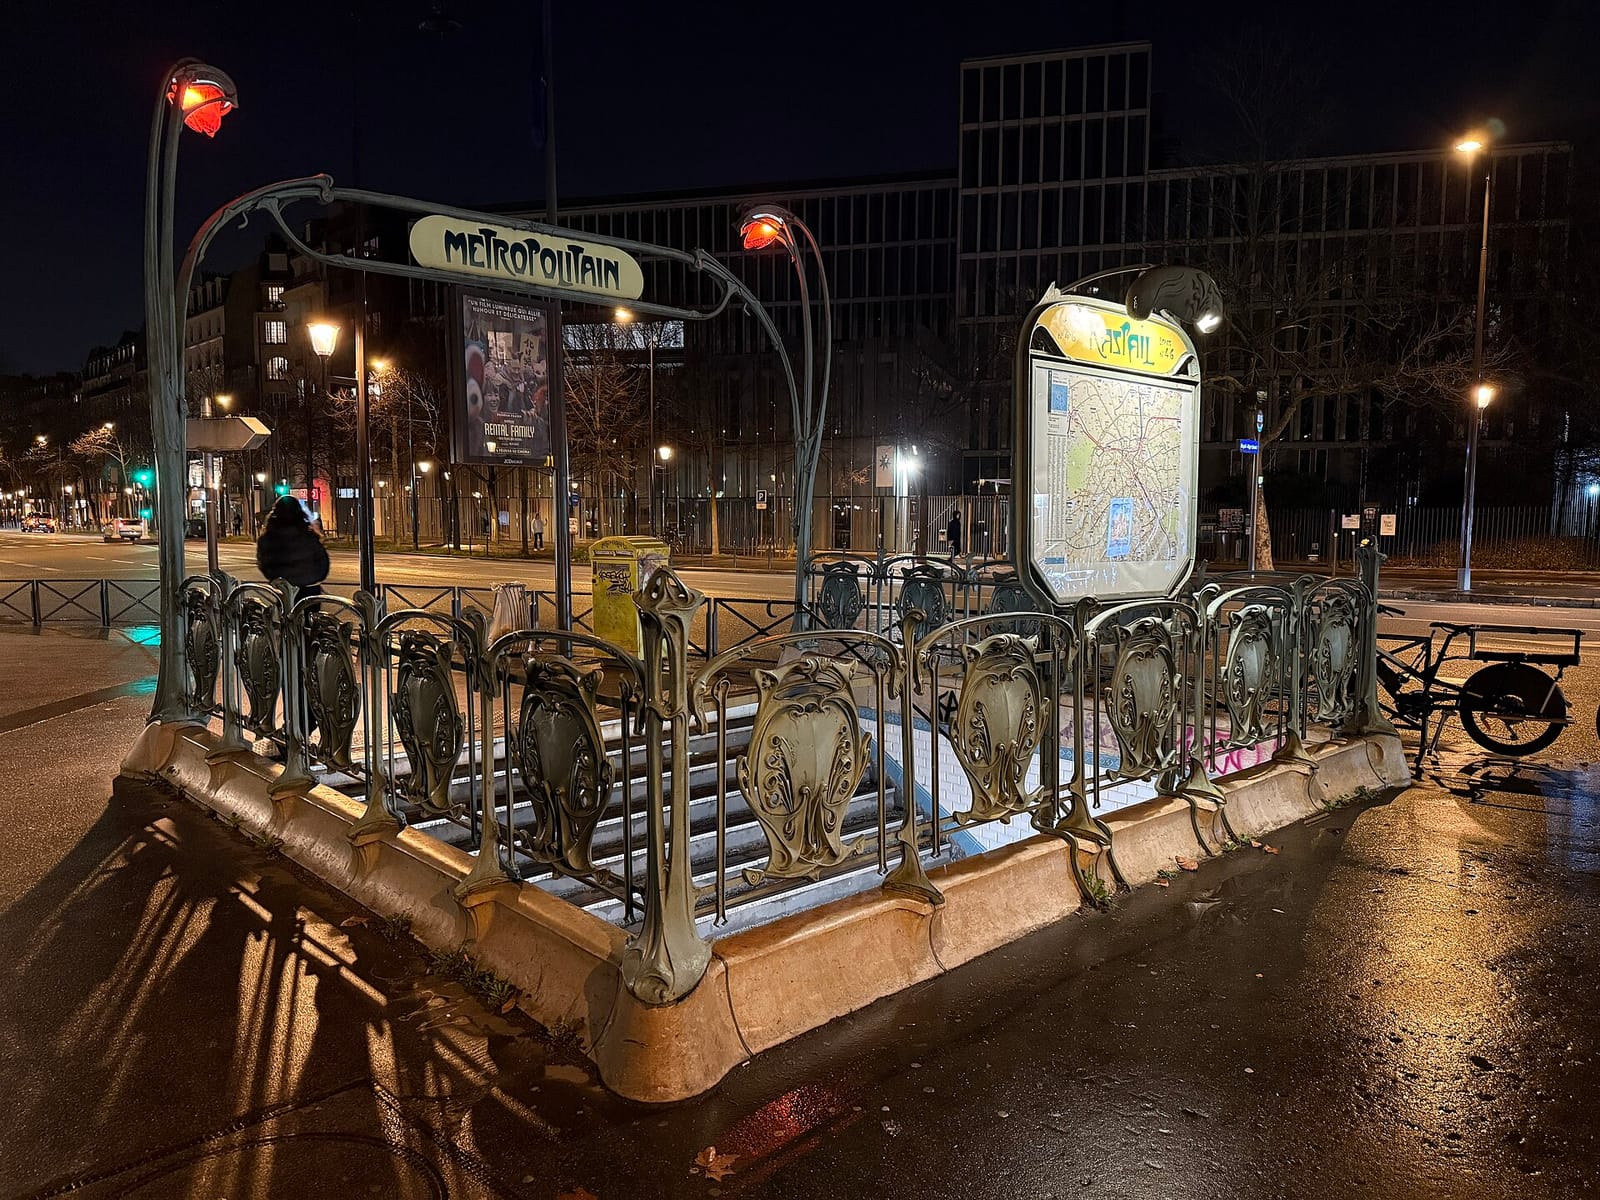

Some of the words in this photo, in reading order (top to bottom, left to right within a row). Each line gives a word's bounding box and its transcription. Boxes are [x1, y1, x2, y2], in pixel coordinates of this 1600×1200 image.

[444, 228, 620, 290] METROPOLITAIN
[479, 301, 491, 309] FILM
[484, 423, 509, 437] RENTAL
[510, 425, 535, 438] FAMILY
